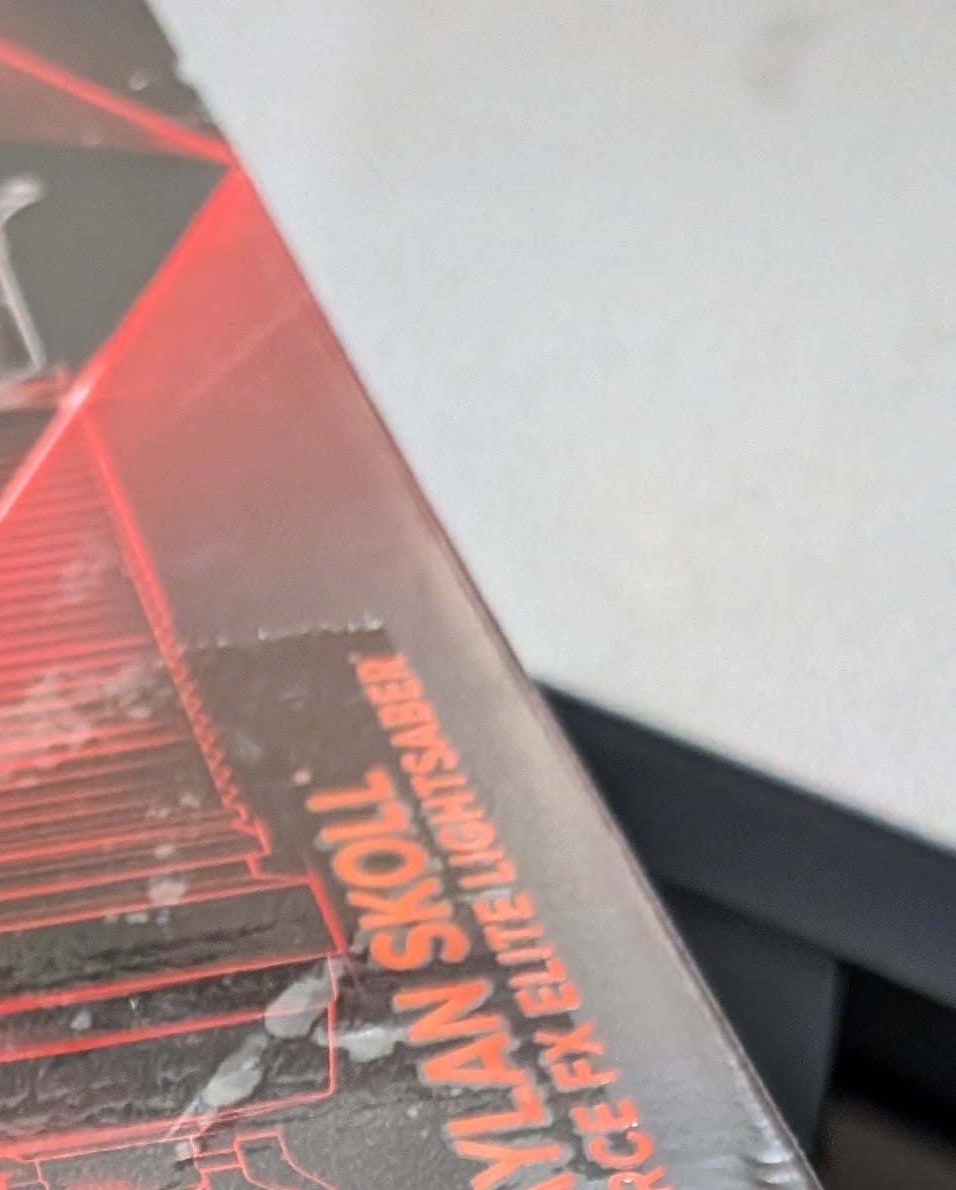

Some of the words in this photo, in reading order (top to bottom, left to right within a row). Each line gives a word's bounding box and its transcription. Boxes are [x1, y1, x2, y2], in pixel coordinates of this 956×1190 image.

[357, 655, 517, 889] LIGHTSABER
[308, 768, 470, 970] SKOLL
[473, 892, 580, 1018] ELITE
[534, 1022, 620, 1089] FX
